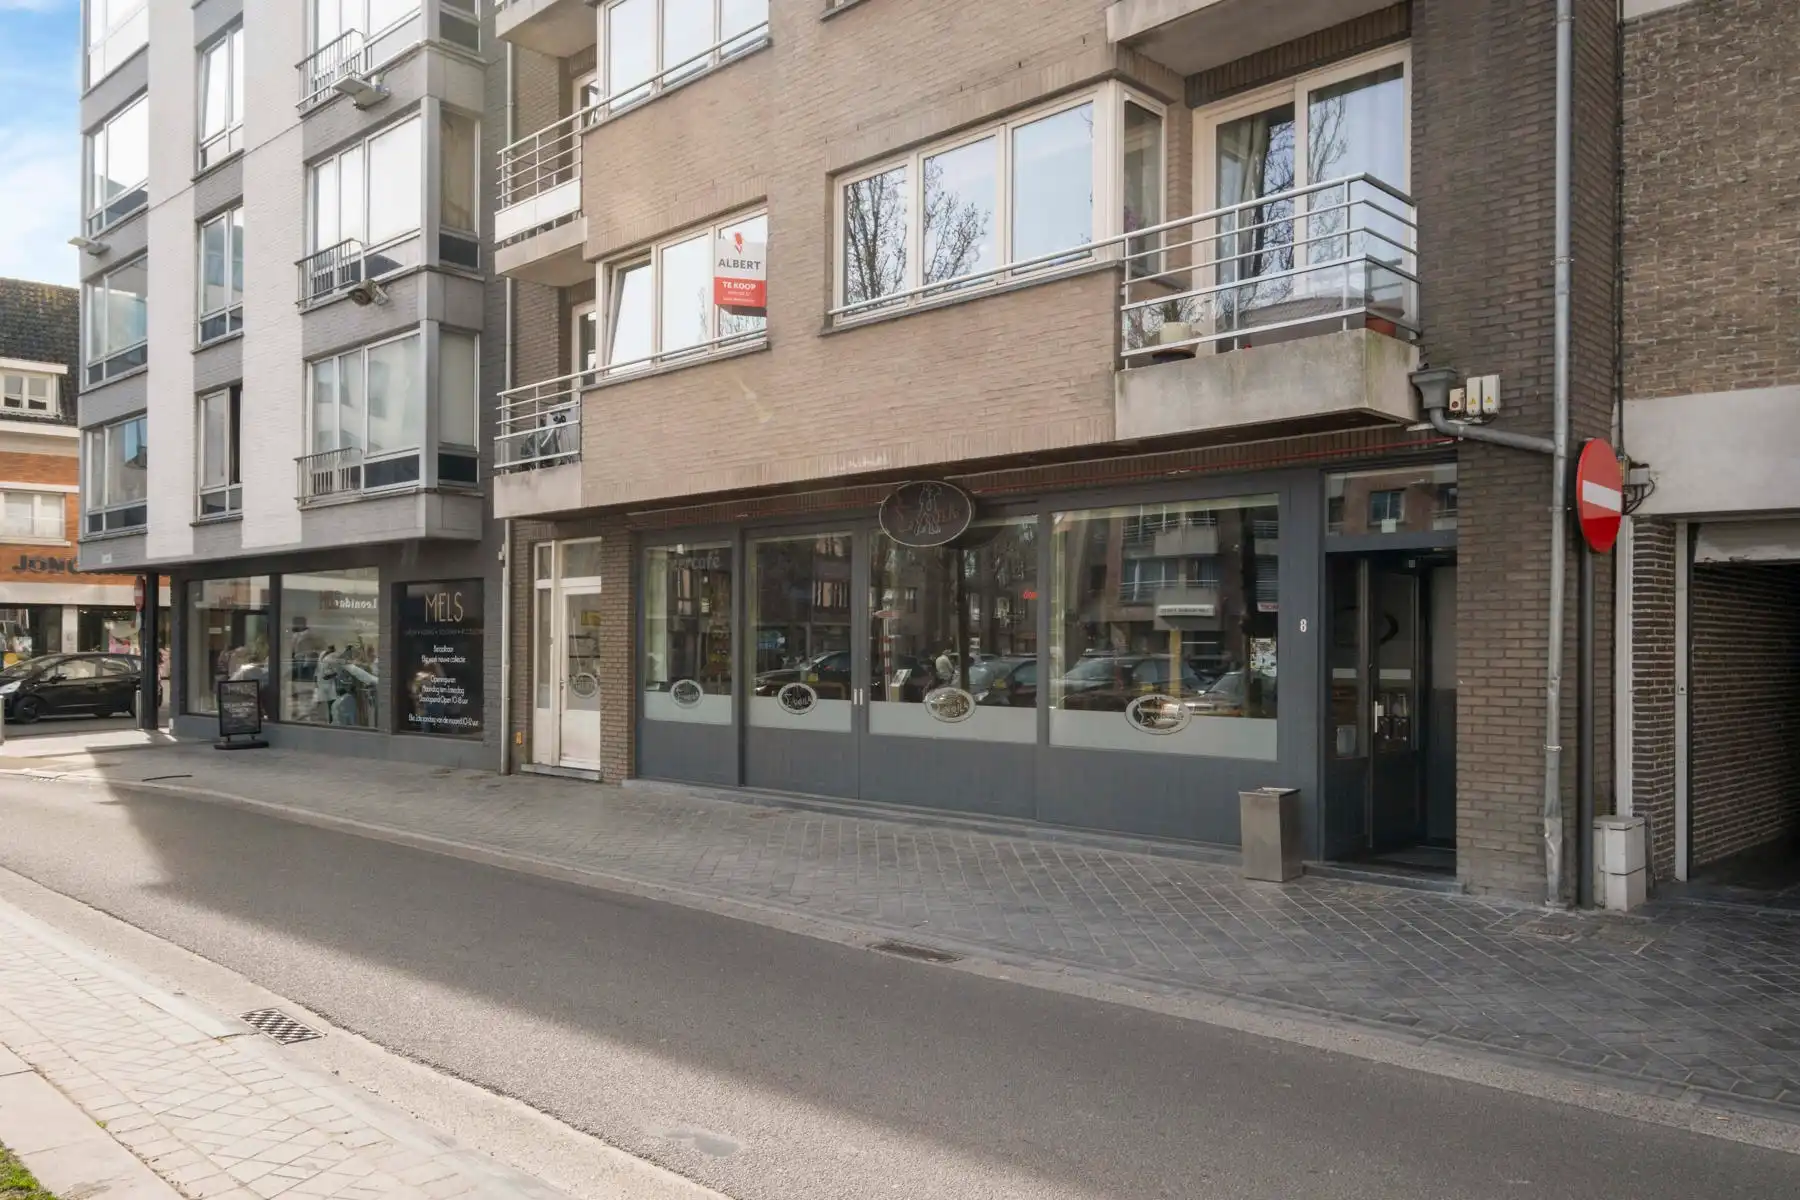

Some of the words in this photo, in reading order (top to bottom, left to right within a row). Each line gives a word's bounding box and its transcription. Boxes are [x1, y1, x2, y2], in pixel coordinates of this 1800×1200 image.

[718, 258, 761, 270] ALBERT
[722, 281, 732, 289] TE
[734, 281, 756, 291] KOOP
[425, 592, 464, 622] MELS
[1300, 618, 1307, 633] 8
